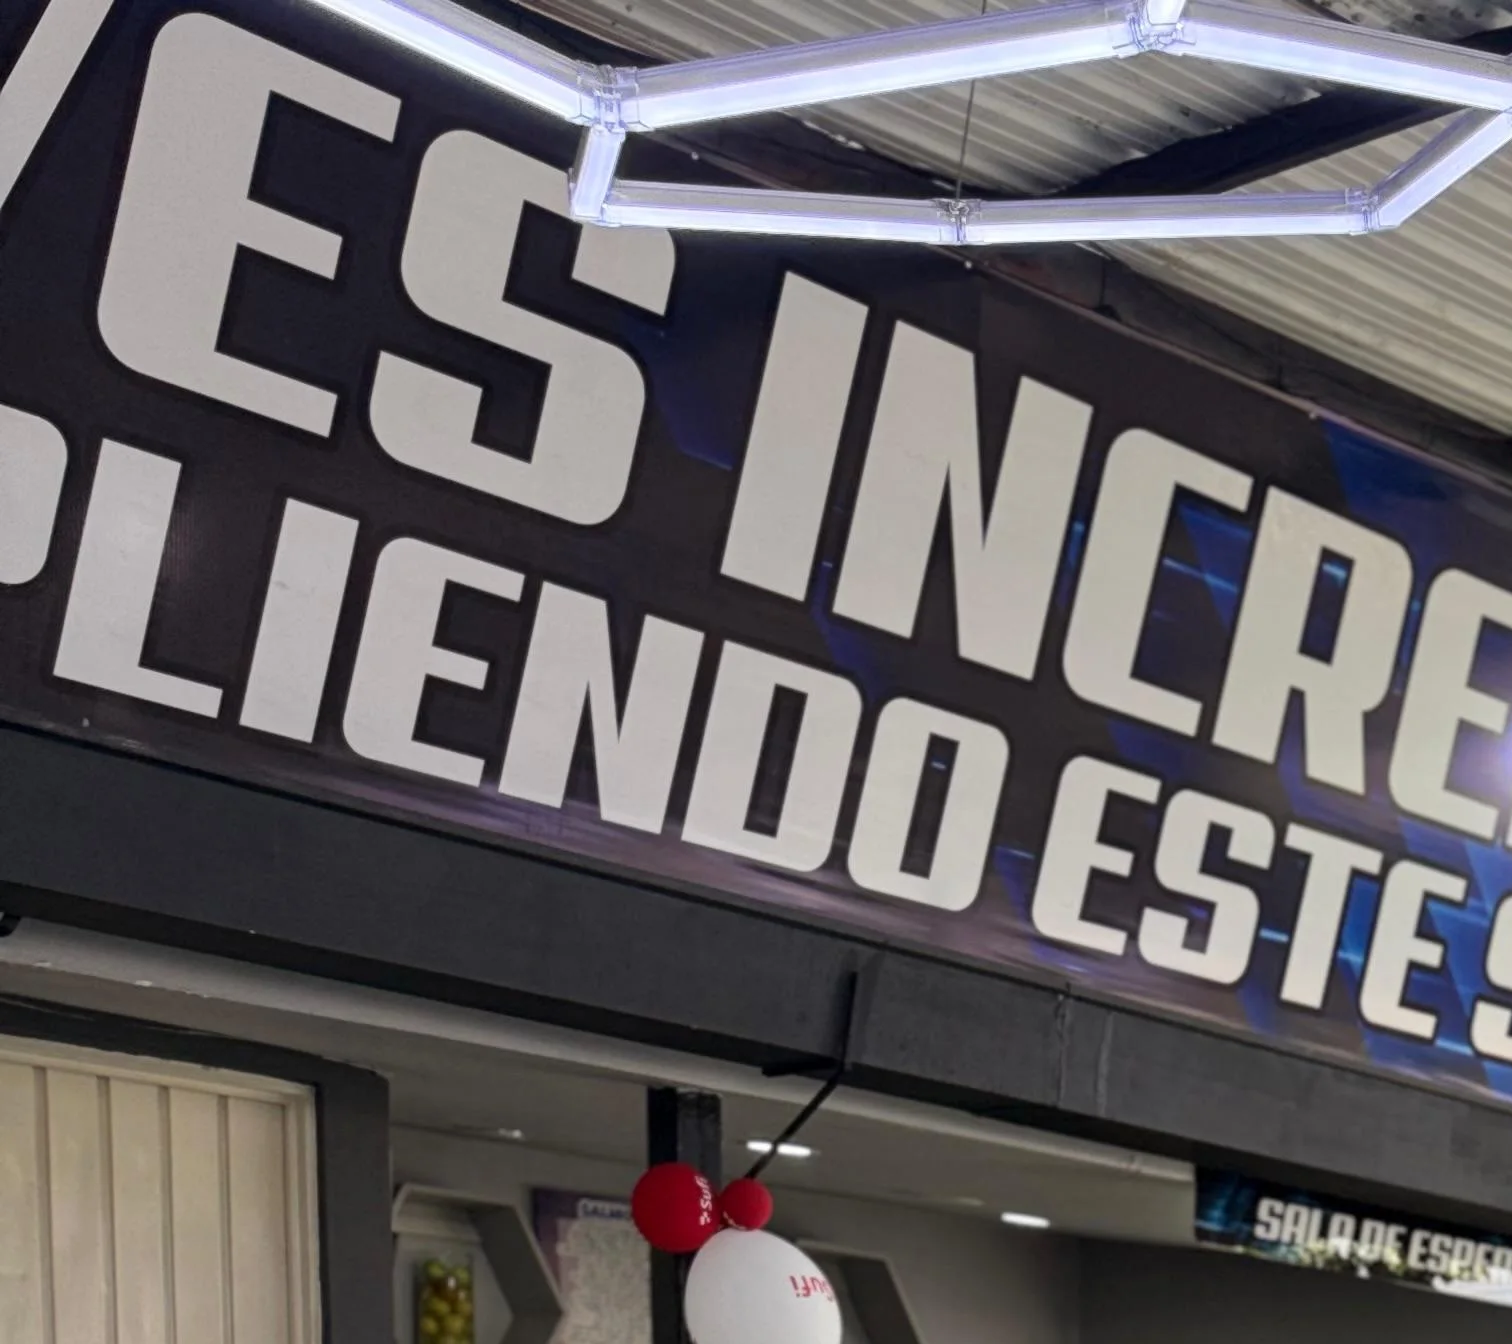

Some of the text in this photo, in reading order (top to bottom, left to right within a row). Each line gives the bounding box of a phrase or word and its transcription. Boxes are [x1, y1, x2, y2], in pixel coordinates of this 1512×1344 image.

[1031, 755, 1468, 1040] ESTE
[1253, 1197, 1356, 1259] SALA
[1358, 1218, 1408, 1267] DE
